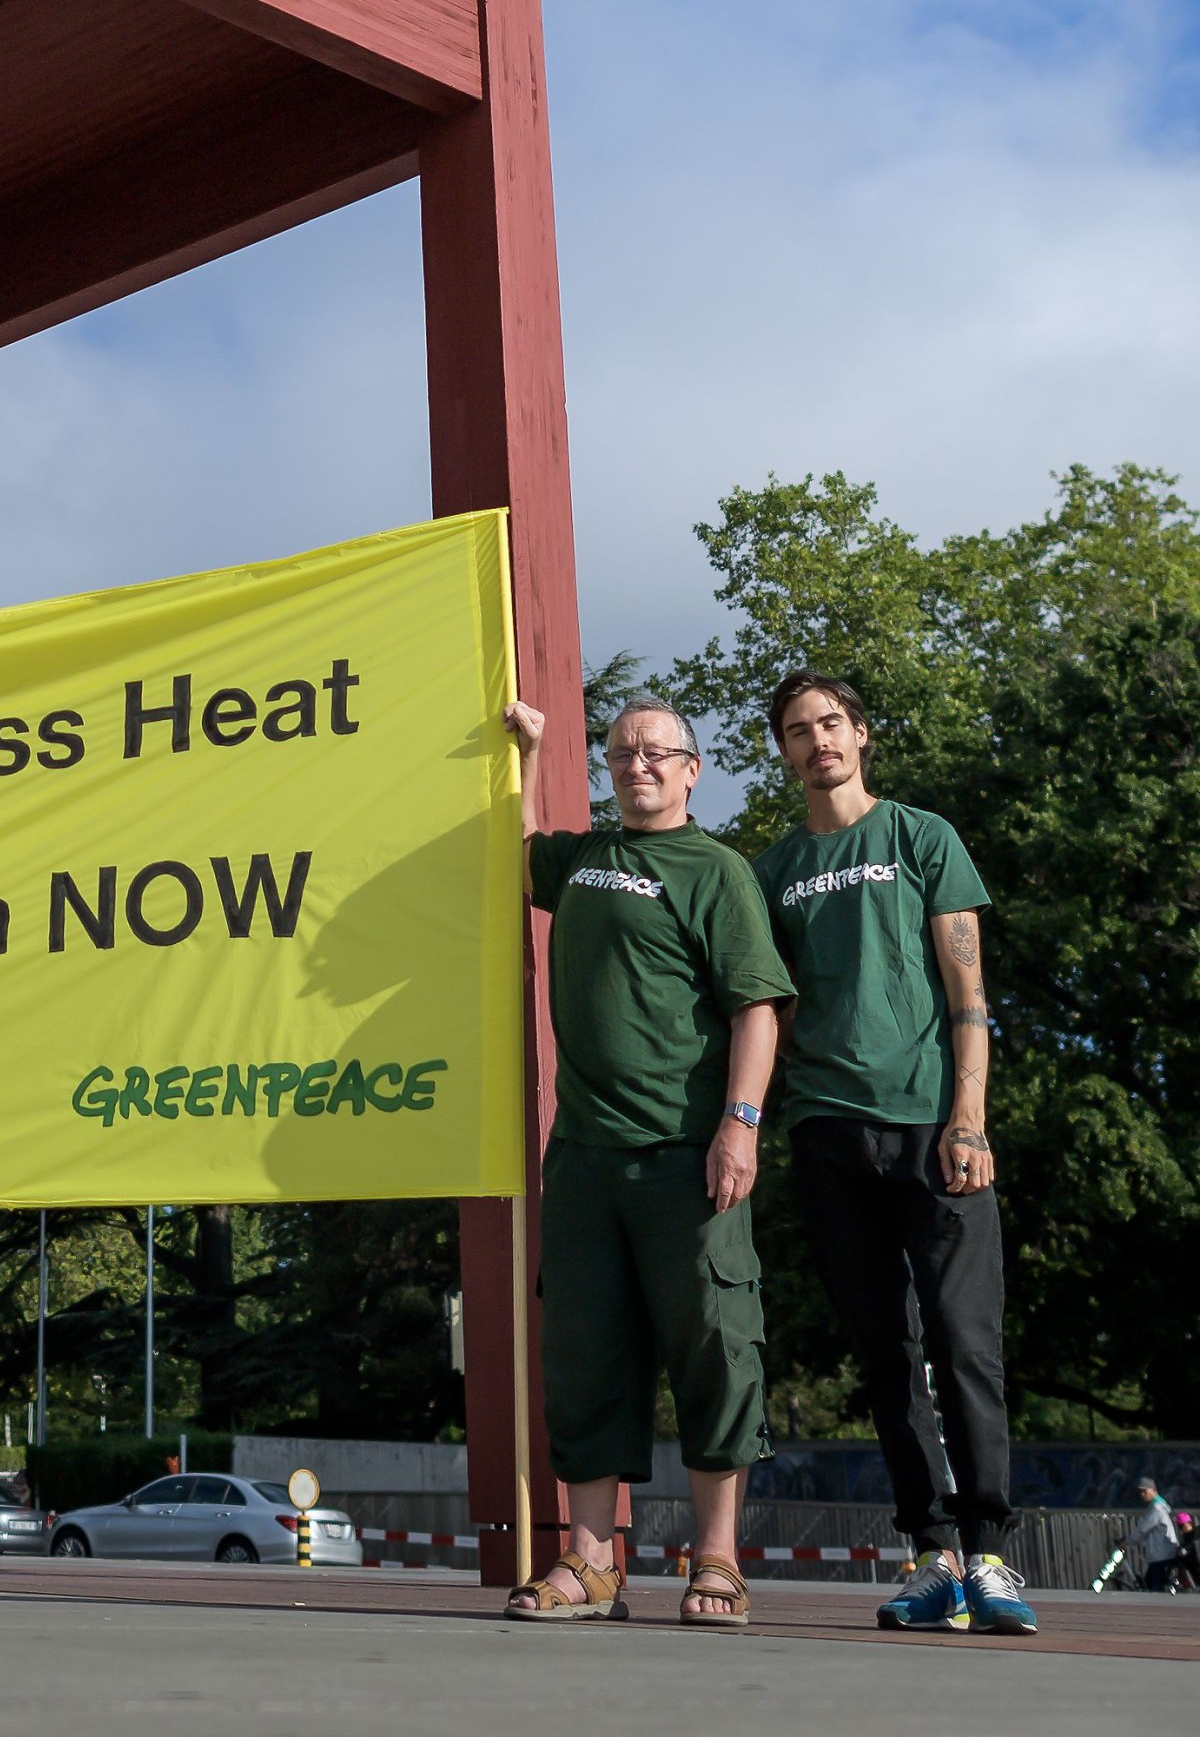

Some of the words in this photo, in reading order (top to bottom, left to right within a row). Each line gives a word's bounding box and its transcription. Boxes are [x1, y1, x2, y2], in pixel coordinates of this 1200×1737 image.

[124, 659, 359, 758] Heat
[49, 851, 312, 953] NOW
[782, 863, 899, 906] GREENPEACE
[72, 1059, 448, 1127] GREENPEACE
